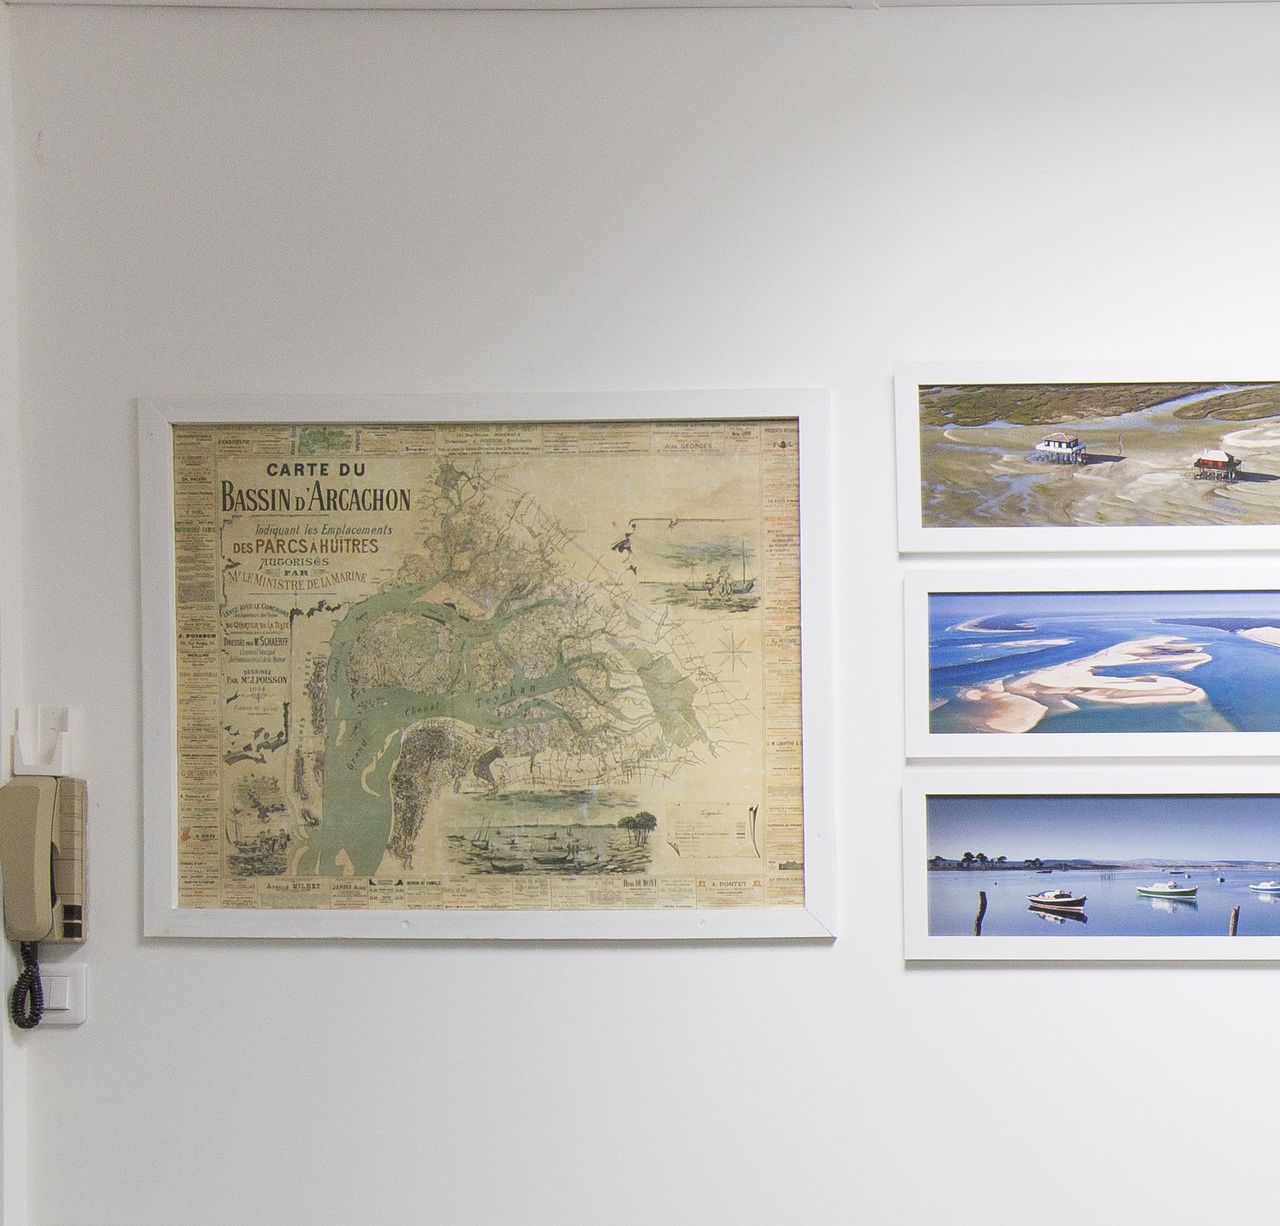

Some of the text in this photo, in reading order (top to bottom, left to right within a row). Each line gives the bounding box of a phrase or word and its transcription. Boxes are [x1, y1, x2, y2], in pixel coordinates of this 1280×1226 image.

[266, 463, 366, 476] CARTE DU
[221, 480, 291, 512] BASSIN
[255, 523, 393, 538] Indiquant les Emplacements
[233, 542, 253, 554] DES
[255, 539, 308, 554] PARCS
[242, 572, 253, 583] LE
[253, 574, 305, 590] MINISTRE
[307, 579, 320, 590] DE
[320, 577, 332, 588] LA
[331, 570, 368, 584] MARINE
[404, 702, 442, 717] Chenal
